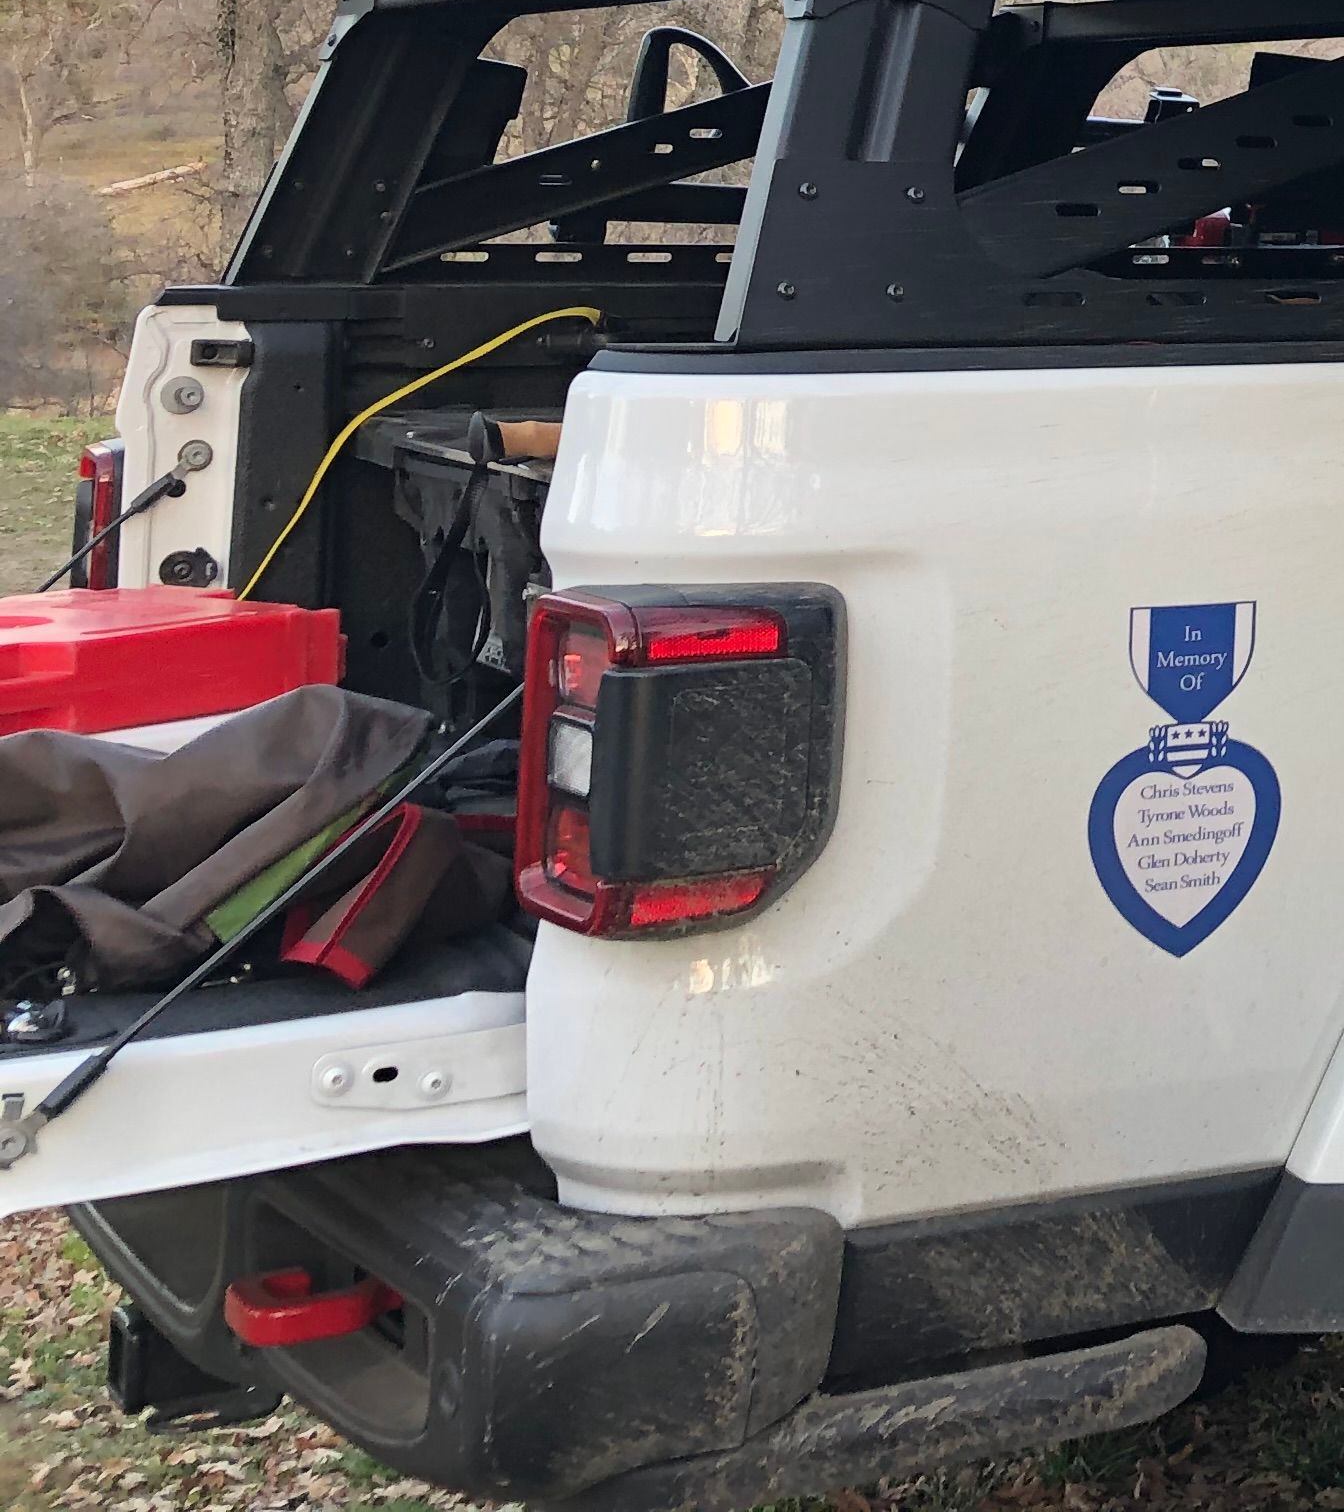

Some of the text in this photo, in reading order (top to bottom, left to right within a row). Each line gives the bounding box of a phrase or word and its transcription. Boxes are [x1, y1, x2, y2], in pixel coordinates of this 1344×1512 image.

[1184, 625, 1202, 642] In
[1156, 650, 1228, 670] Memory
[1180, 672, 1205, 691] Of
[1140, 781, 1234, 800] Chris Stevens
[1137, 800, 1235, 828] Tyrone Woods
[1127, 821, 1245, 849] Ann Smedingoff
[1137, 849, 1230, 870] Glen Doherty
[1144, 870, 1221, 893] Sean Smith
